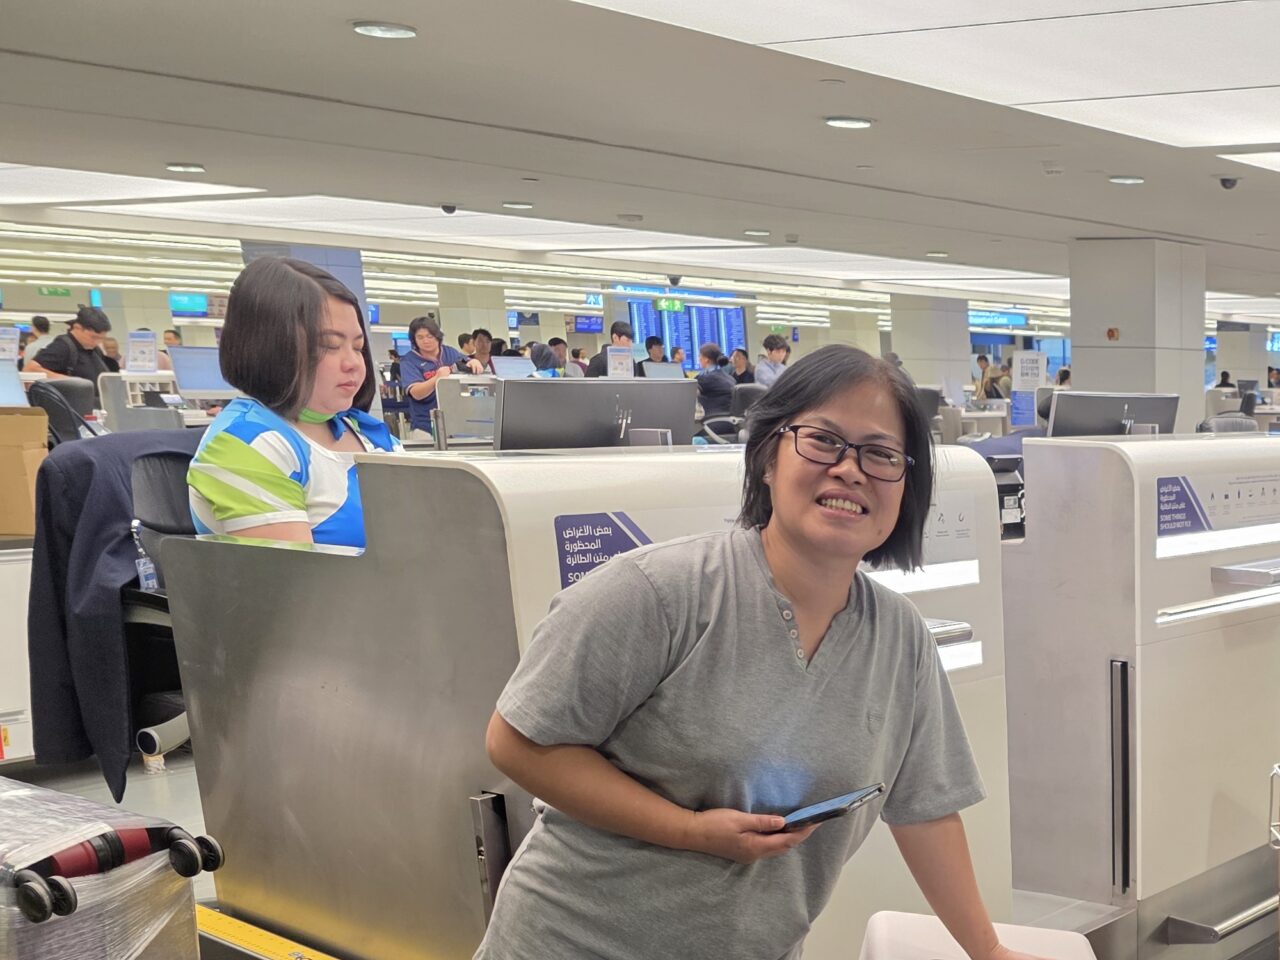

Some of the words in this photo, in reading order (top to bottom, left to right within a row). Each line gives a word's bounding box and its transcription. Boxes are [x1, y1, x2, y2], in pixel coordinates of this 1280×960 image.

[593, 526, 612, 536] بعض
[565, 539, 601, 552] المحظورة
[566, 554, 592, 566] الطائرة
[568, 571, 588, 582] SO
